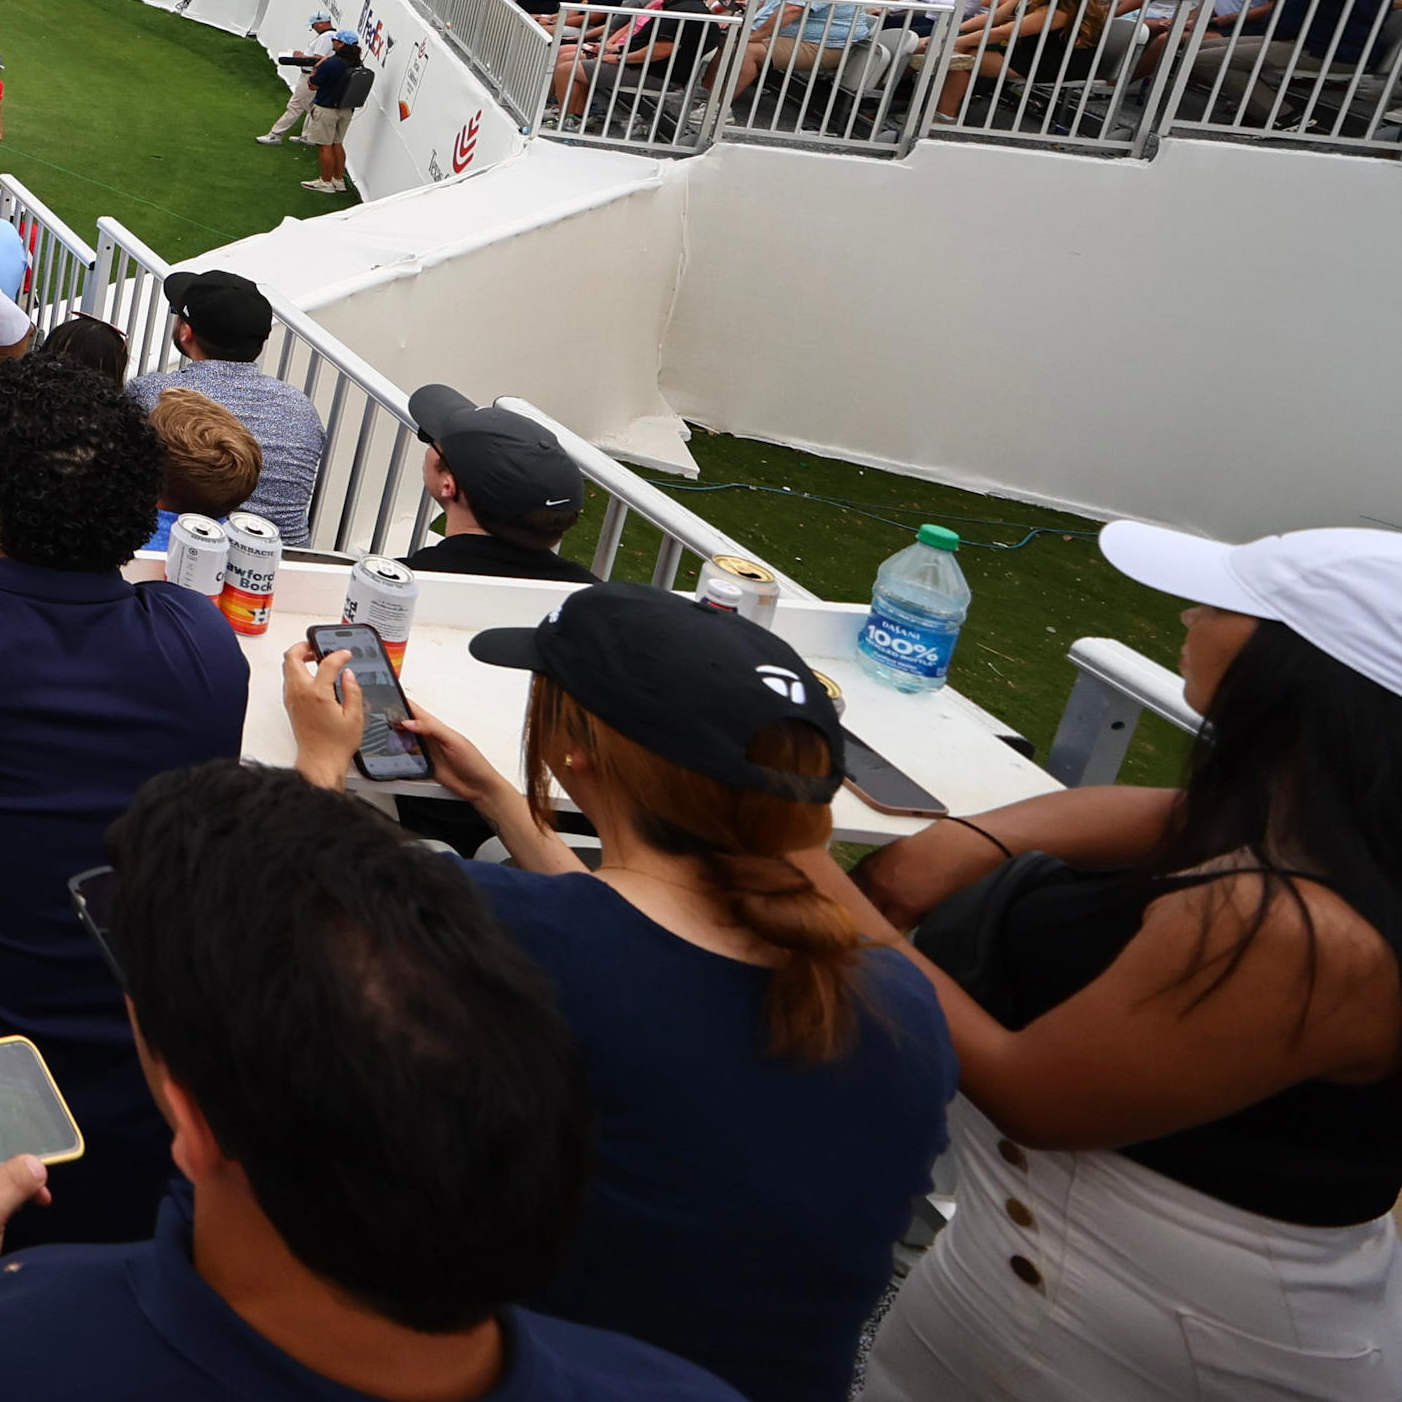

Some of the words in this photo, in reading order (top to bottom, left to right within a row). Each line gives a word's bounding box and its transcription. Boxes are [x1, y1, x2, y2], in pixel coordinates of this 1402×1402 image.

[361, 9, 384, 61] FedEx
[227, 561, 275, 582] awford
[240, 577, 273, 592] Bock
[882, 620, 921, 640] DASANI
[868, 625, 938, 662] 100%
